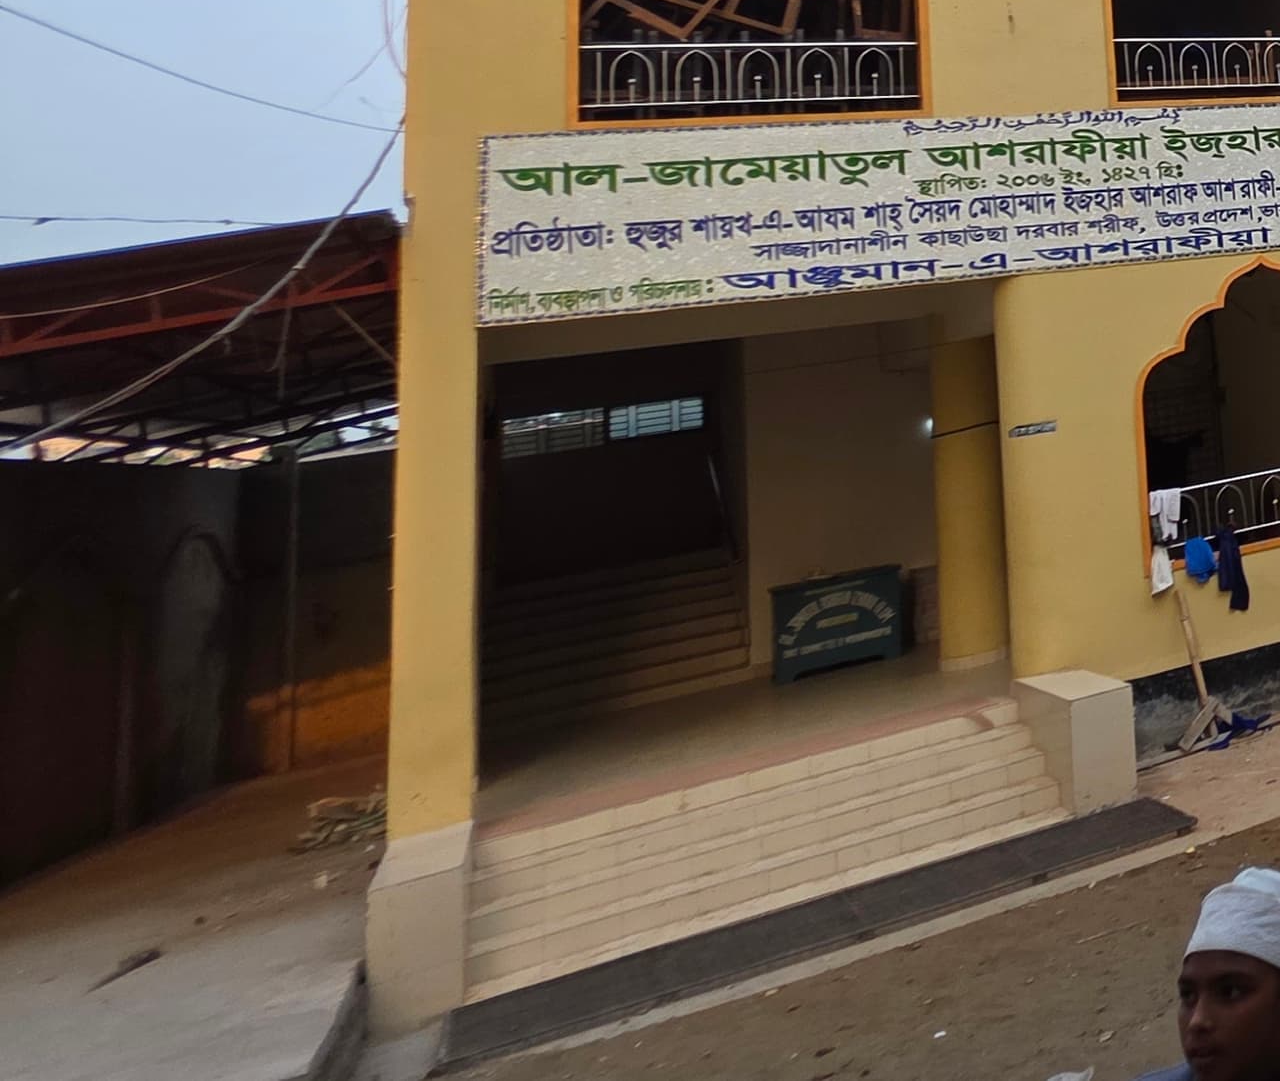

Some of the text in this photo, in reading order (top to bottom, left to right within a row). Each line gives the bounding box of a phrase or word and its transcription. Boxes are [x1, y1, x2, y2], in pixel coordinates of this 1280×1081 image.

[495, 149, 912, 196] আল-জামেয়াতুল
[921, 129, 1151, 170] আশরাফীয়া
[996, 172, 1055, 190] ২০০৬
[1101, 165, 1151, 184] ১৪২৭
[623, 219, 684, 252] হুজুর
[904, 195, 963, 225] সৈয়দ
[1063, 183, 1125, 214] ইজহার
[1129, 181, 1199, 210] আশরাফ
[751, 230, 909, 262] সাজ্জাদানাশীন
[917, 224, 1008, 249] কাছাউছা
[1015, 220, 1079, 241] দরবার
[1085, 213, 1147, 235] শরীফ,
[608, 285, 624, 304] ও
